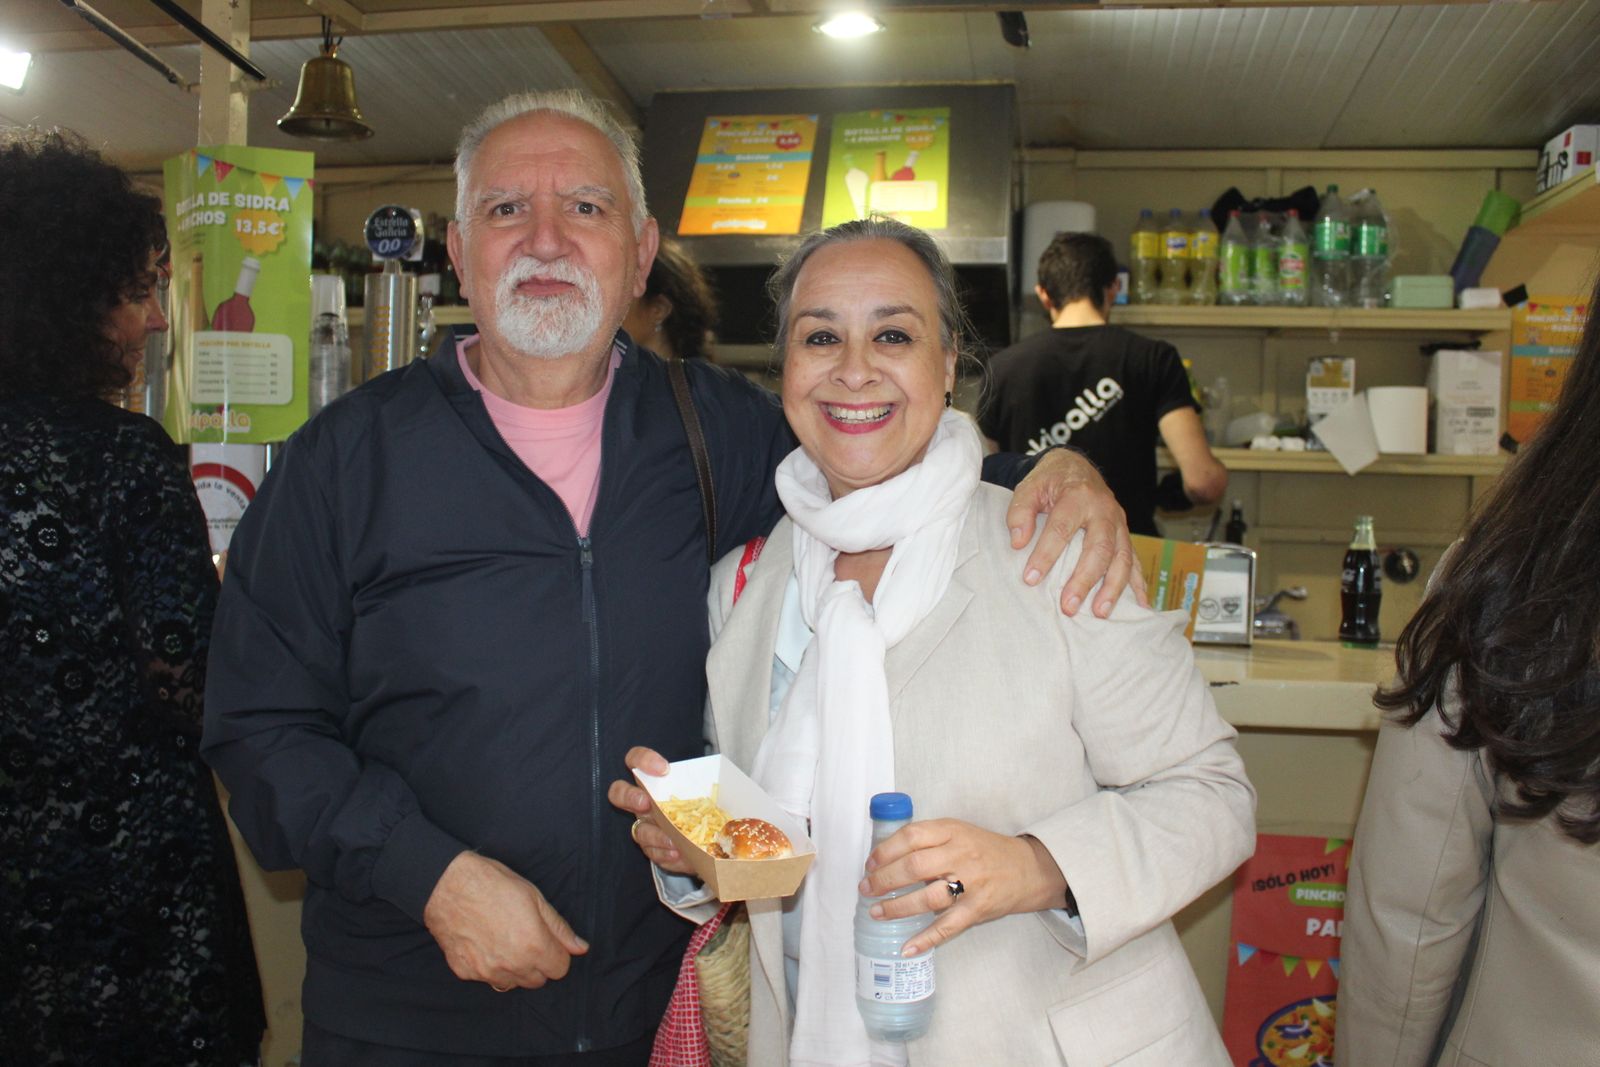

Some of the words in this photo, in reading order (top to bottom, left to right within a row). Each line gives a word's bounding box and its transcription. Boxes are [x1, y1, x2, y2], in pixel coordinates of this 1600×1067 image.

[208, 192, 230, 206] DE
[234, 193, 290, 211] SIDRA
[1300, 863, 1336, 882] HOY!
